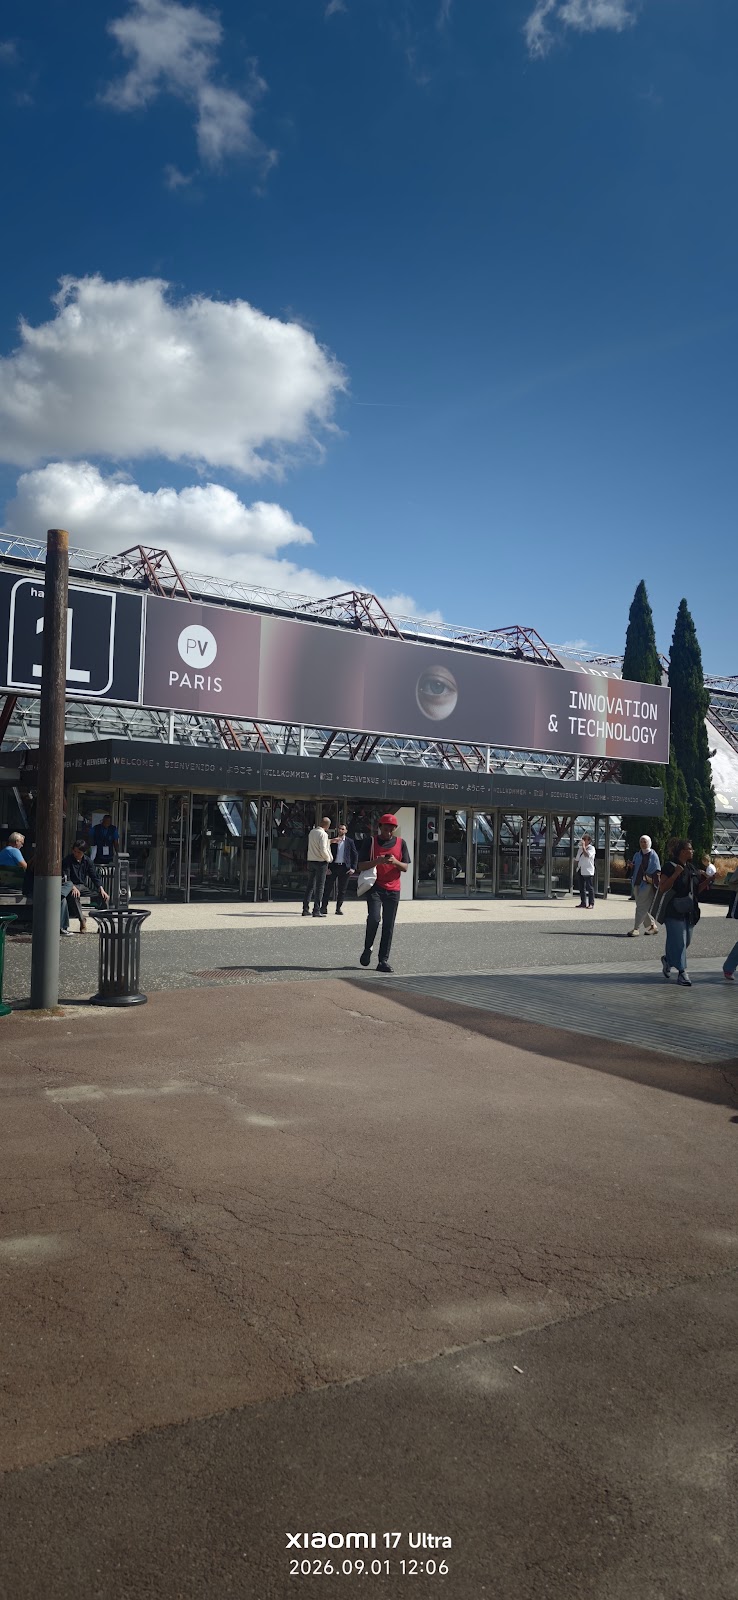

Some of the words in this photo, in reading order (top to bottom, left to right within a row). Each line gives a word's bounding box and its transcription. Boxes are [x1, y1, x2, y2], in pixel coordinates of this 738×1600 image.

[30, 586, 45, 598] ha
[32, 607, 91, 684] 1
[186, 638, 209, 657] PV
[168, 670, 223, 693] PARIS
[568, 690, 658, 721] INNOVATION
[547, 713, 559, 733] &
[568, 716, 658, 745] TECHNOLOGY
[113, 756, 155, 768] WELCOME
[164, 760, 216, 772] BIENVENIDO
[263, 769, 310, 779] WILLKOMMEN
[342, 774, 380, 785] BIENVENUE
[388, 778, 417, 787] WELCOME
